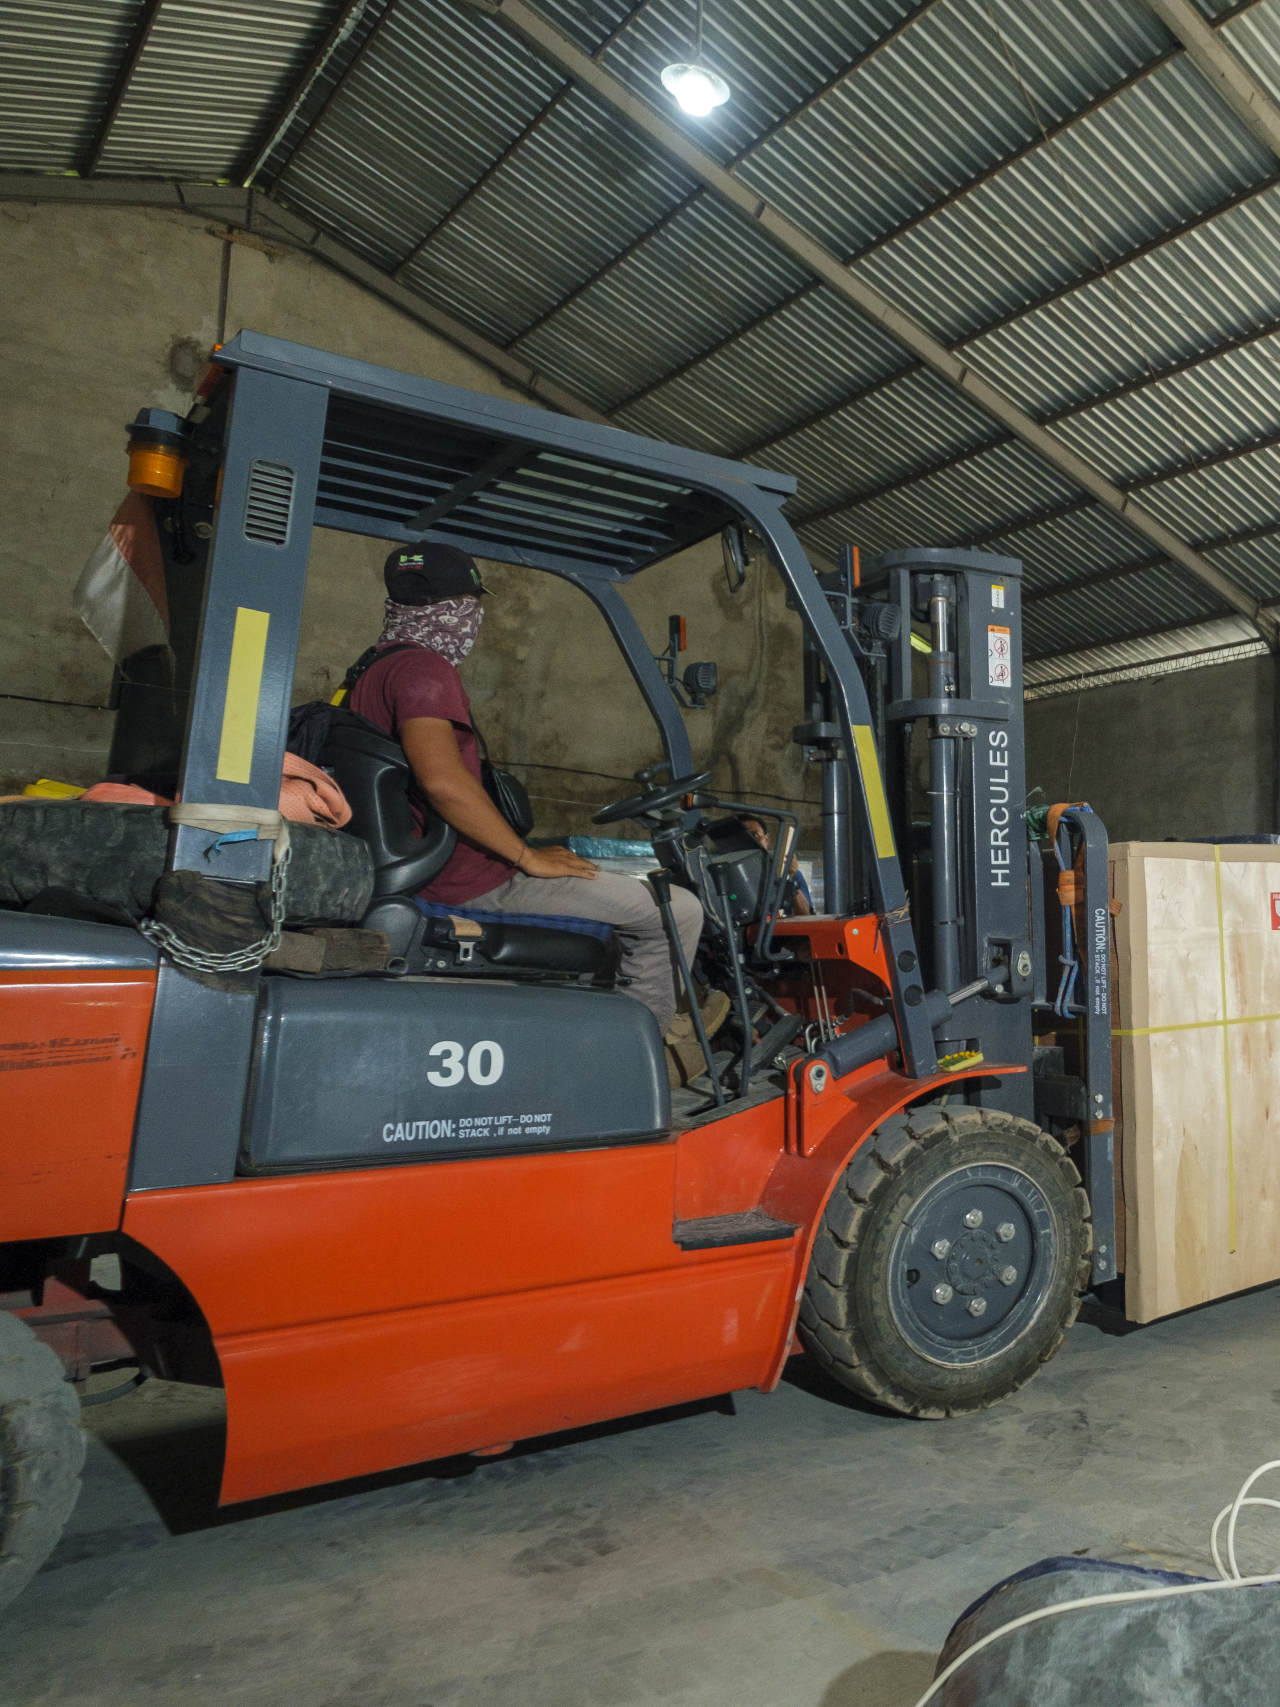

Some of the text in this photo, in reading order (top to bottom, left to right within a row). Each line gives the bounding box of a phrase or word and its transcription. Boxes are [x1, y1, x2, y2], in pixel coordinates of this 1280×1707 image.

[989, 731, 1010, 886] HERCULES
[1094, 908, 1106, 952] CAUTION:
[1100, 953, 1106, 962] DO
[427, 1040, 505, 1087] 30
[382, 1119, 457, 1143] CAUTION:
[458, 1127, 490, 1139] STACK
[507, 1126, 522, 1135] not
[524, 1124, 551, 1136] empty
[459, 1117, 473, 1128] DO
[474, 1116, 493, 1127] NOT
[534, 1113, 553, 1123] NOT
